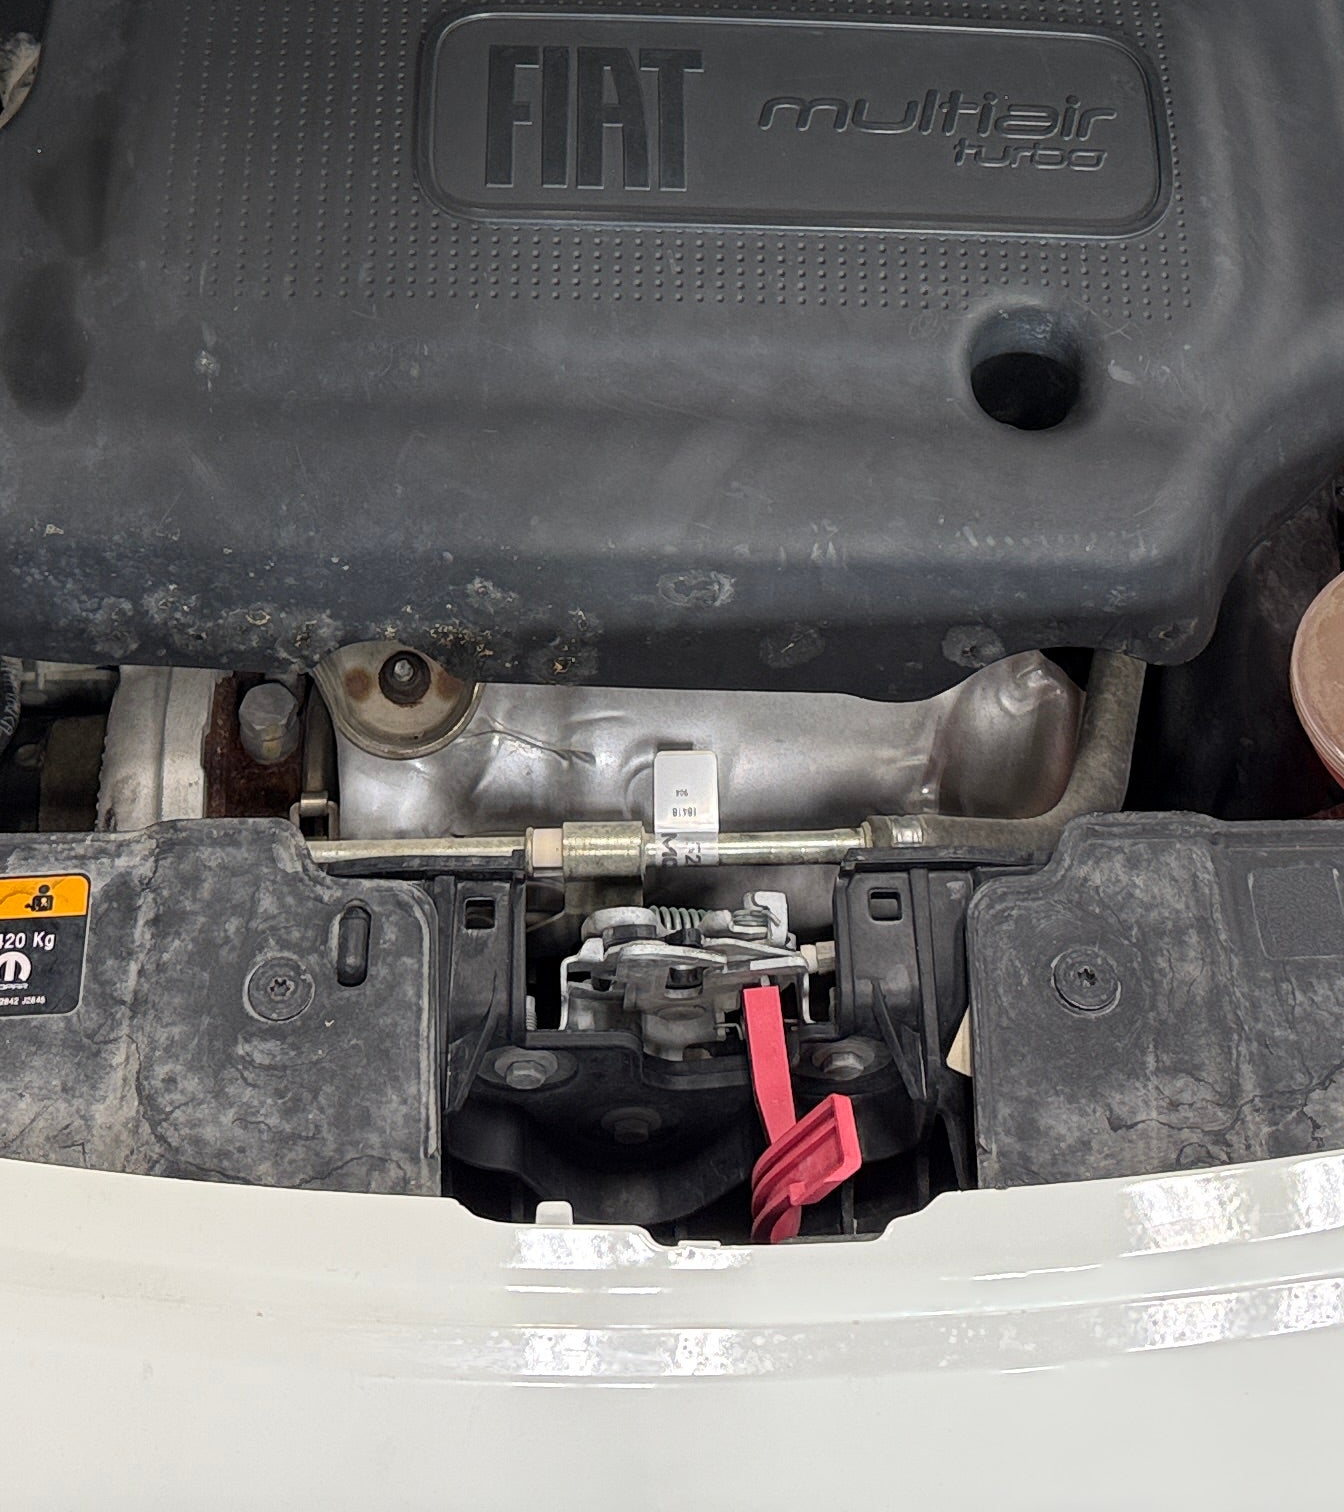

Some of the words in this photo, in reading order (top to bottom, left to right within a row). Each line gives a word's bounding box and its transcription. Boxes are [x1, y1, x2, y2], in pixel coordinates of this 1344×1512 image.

[485, 44, 704, 192] FIAT
[953, 140, 1109, 172] turbo
[32, 931, 56, 950] Kg
